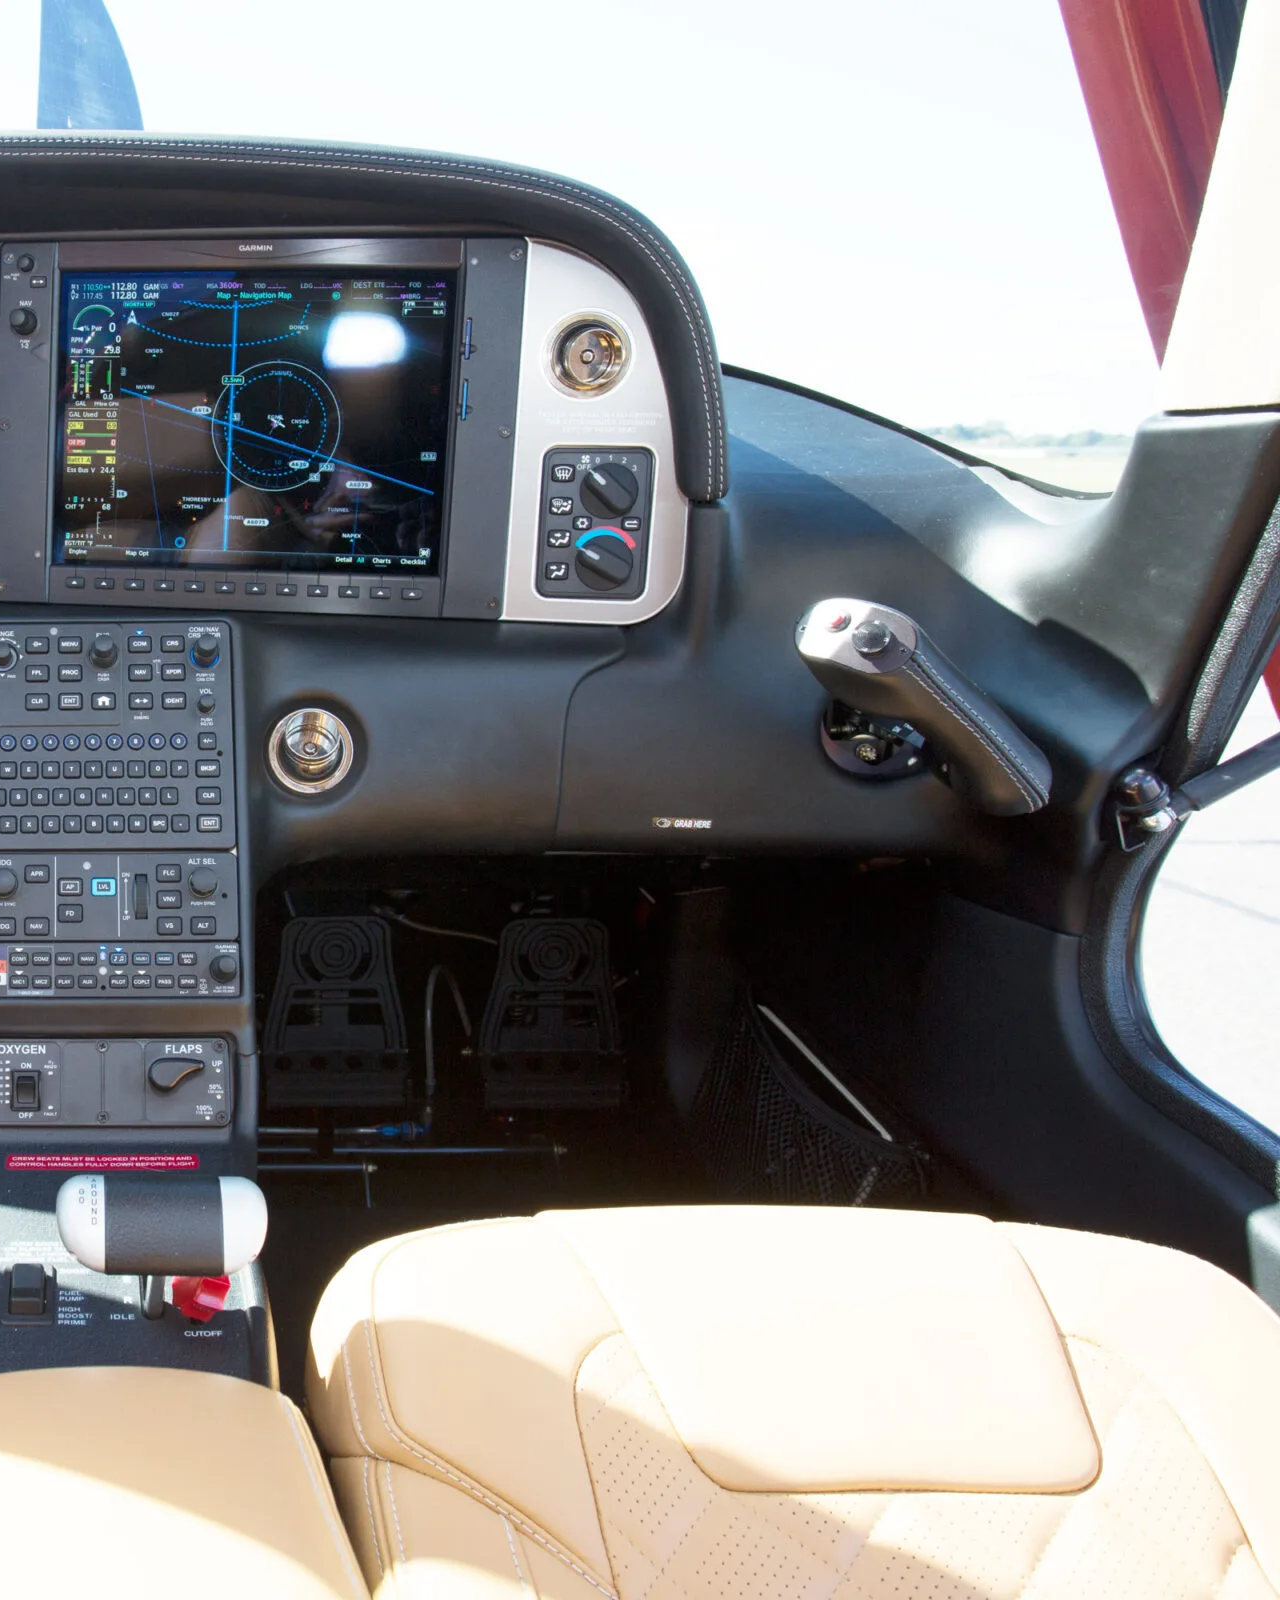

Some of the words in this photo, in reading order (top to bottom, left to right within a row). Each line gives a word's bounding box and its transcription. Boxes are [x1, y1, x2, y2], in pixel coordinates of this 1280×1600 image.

[217, 292, 231, 300] Map
[240, 292, 276, 300] Navigation
[278, 292, 292, 300] Map
[104, 347, 120, 355] 29.8
[674, 819, 693, 828] GRAB
[694, 820, 712, 829] HERE
[165, 1044, 203, 1054] FLAPS
[78, 1188, 85, 1204] GO
